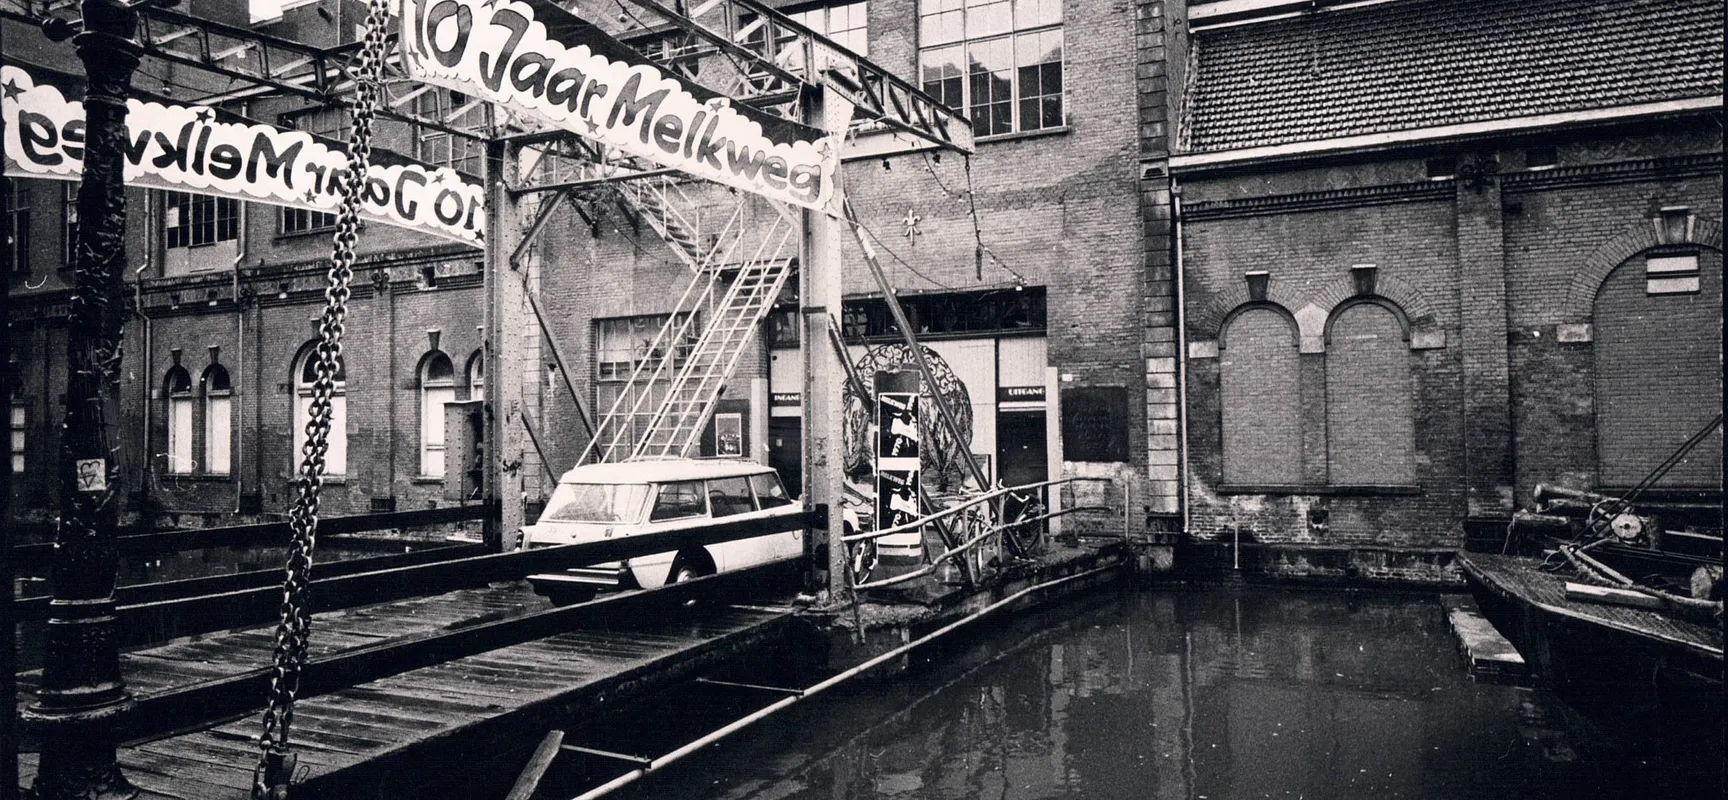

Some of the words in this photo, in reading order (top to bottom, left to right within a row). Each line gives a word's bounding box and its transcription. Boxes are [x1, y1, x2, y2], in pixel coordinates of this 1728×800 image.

[411, 0, 473, 68] 10
[479, 8, 608, 119] Jaar
[606, 72, 822, 201] Melkweg
[1008, 388, 1045, 396] UITGANG
